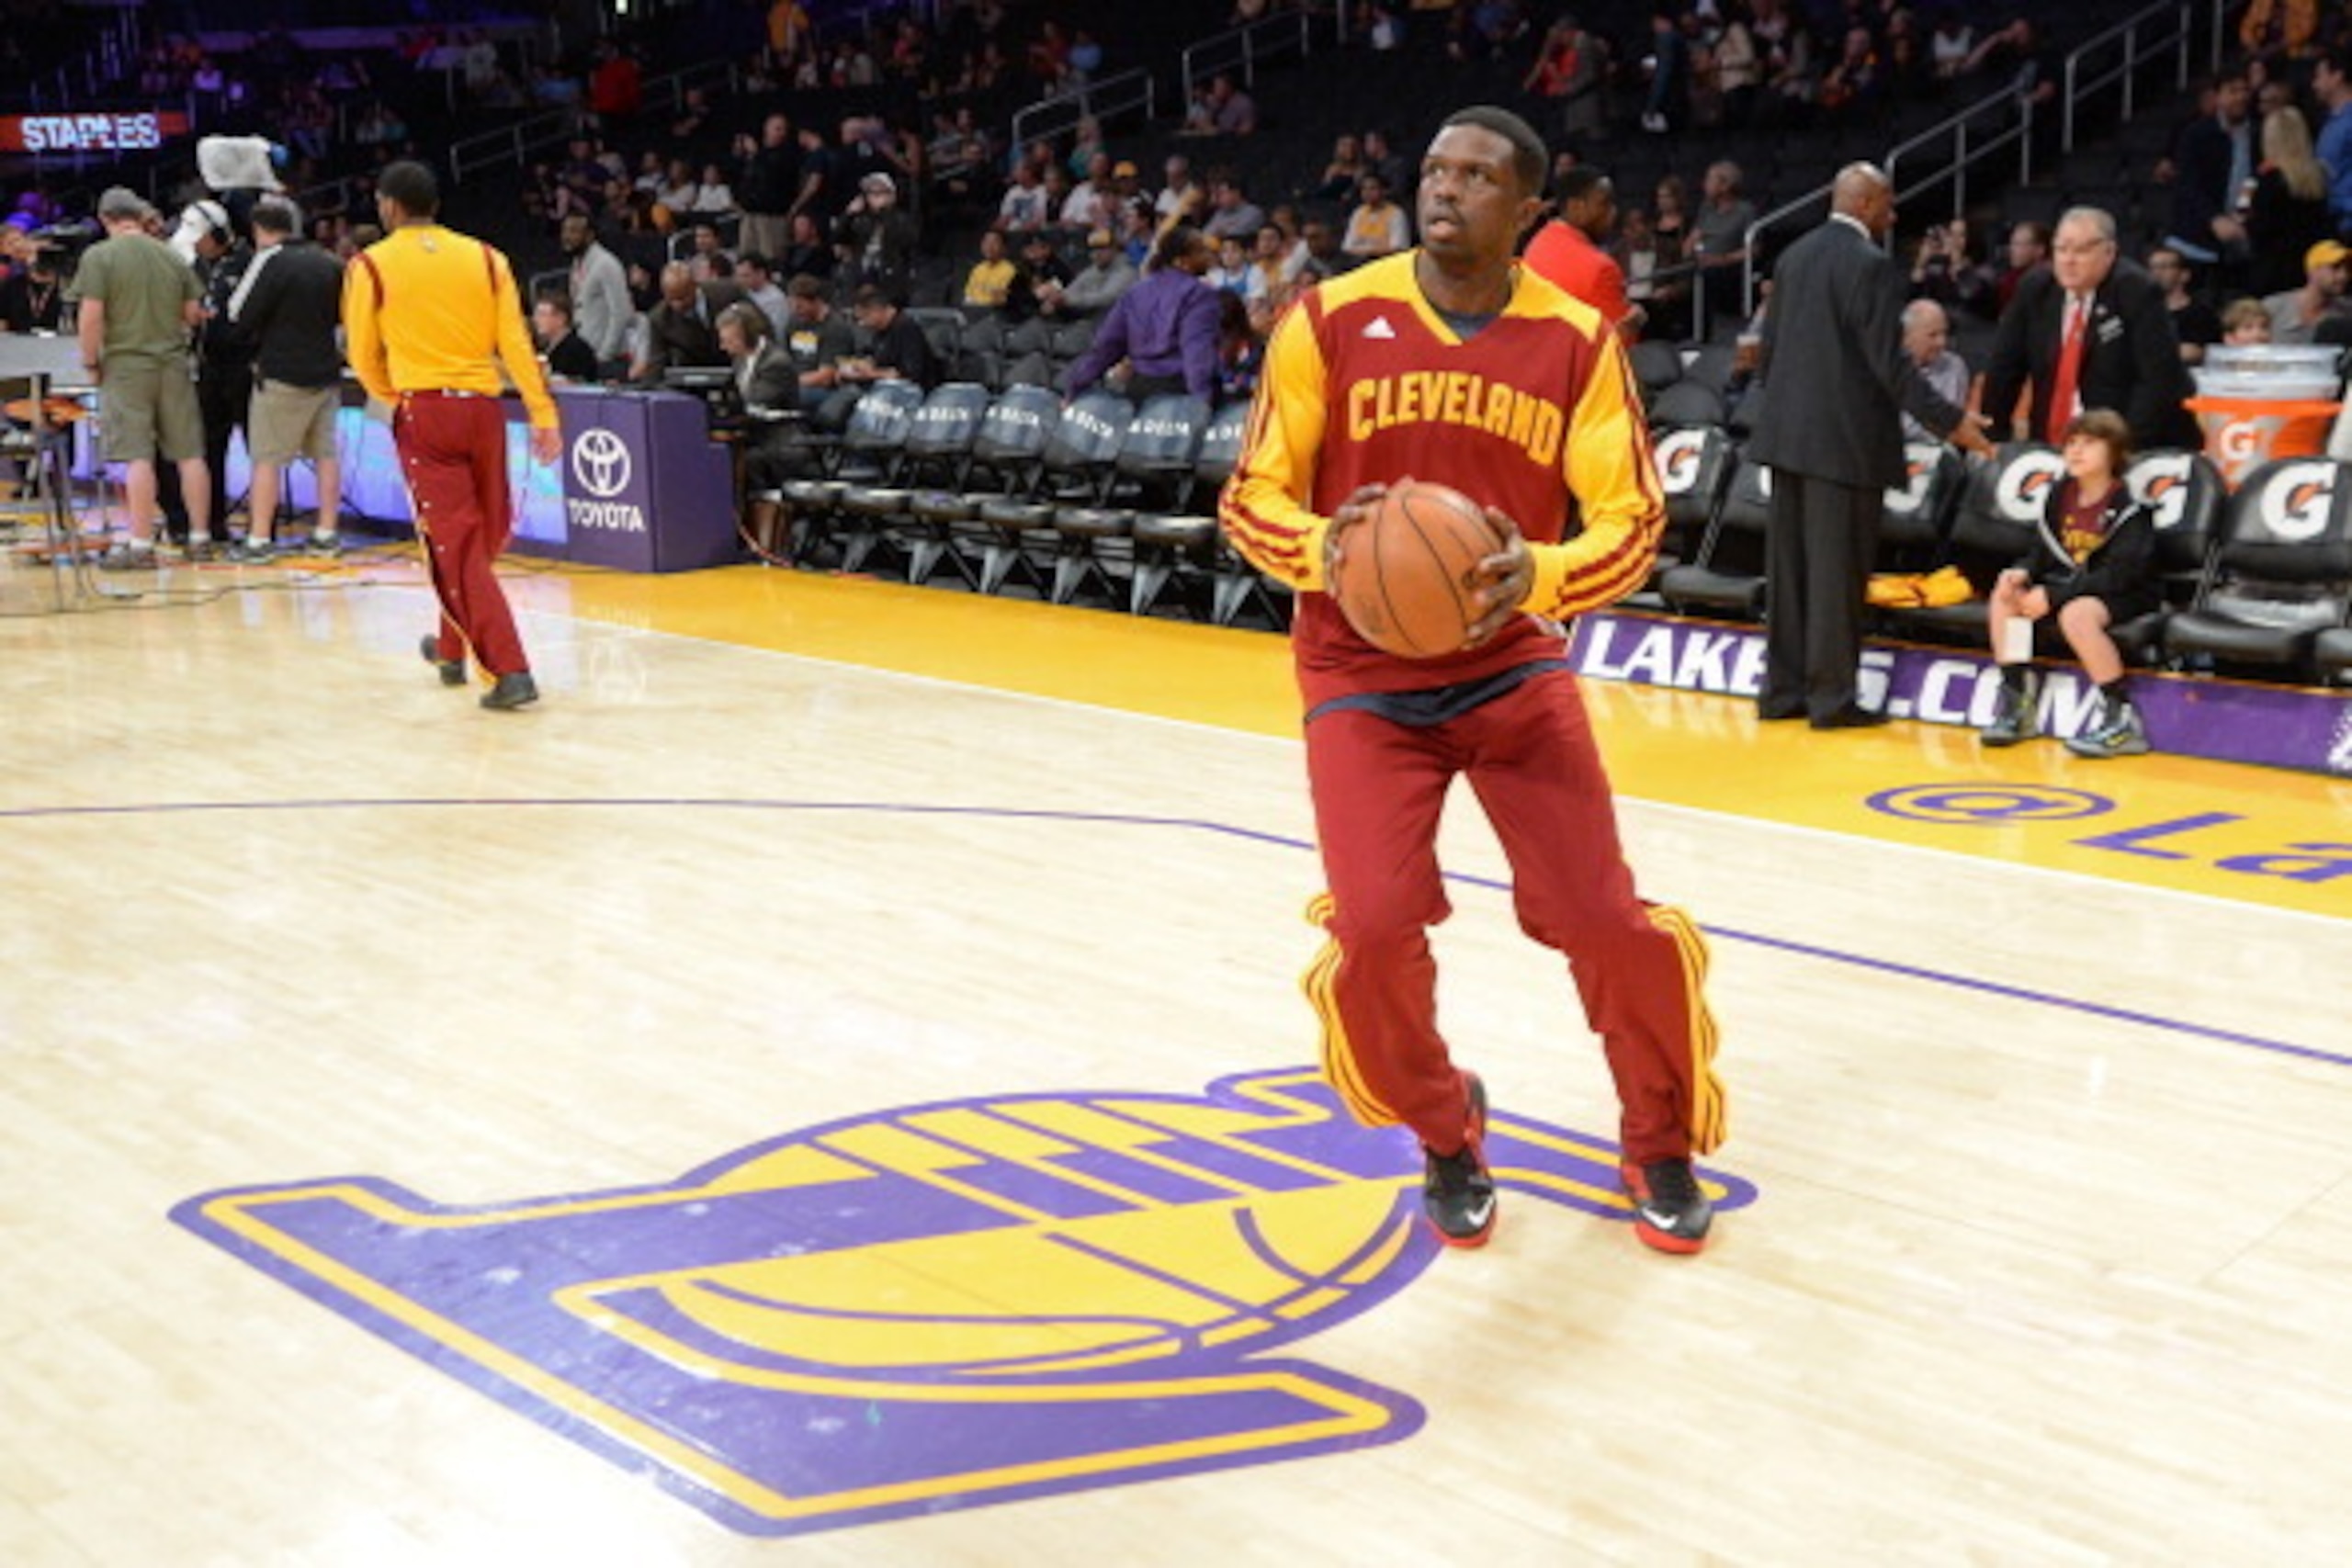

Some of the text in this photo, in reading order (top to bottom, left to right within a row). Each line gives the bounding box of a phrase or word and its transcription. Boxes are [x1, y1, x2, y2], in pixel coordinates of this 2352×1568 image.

[21, 113, 161, 152] STAPLES
[1349, 370, 1562, 467] CLEVELAND
[568, 498, 647, 532] TOYOTA
[2260, 462, 2338, 540] G
